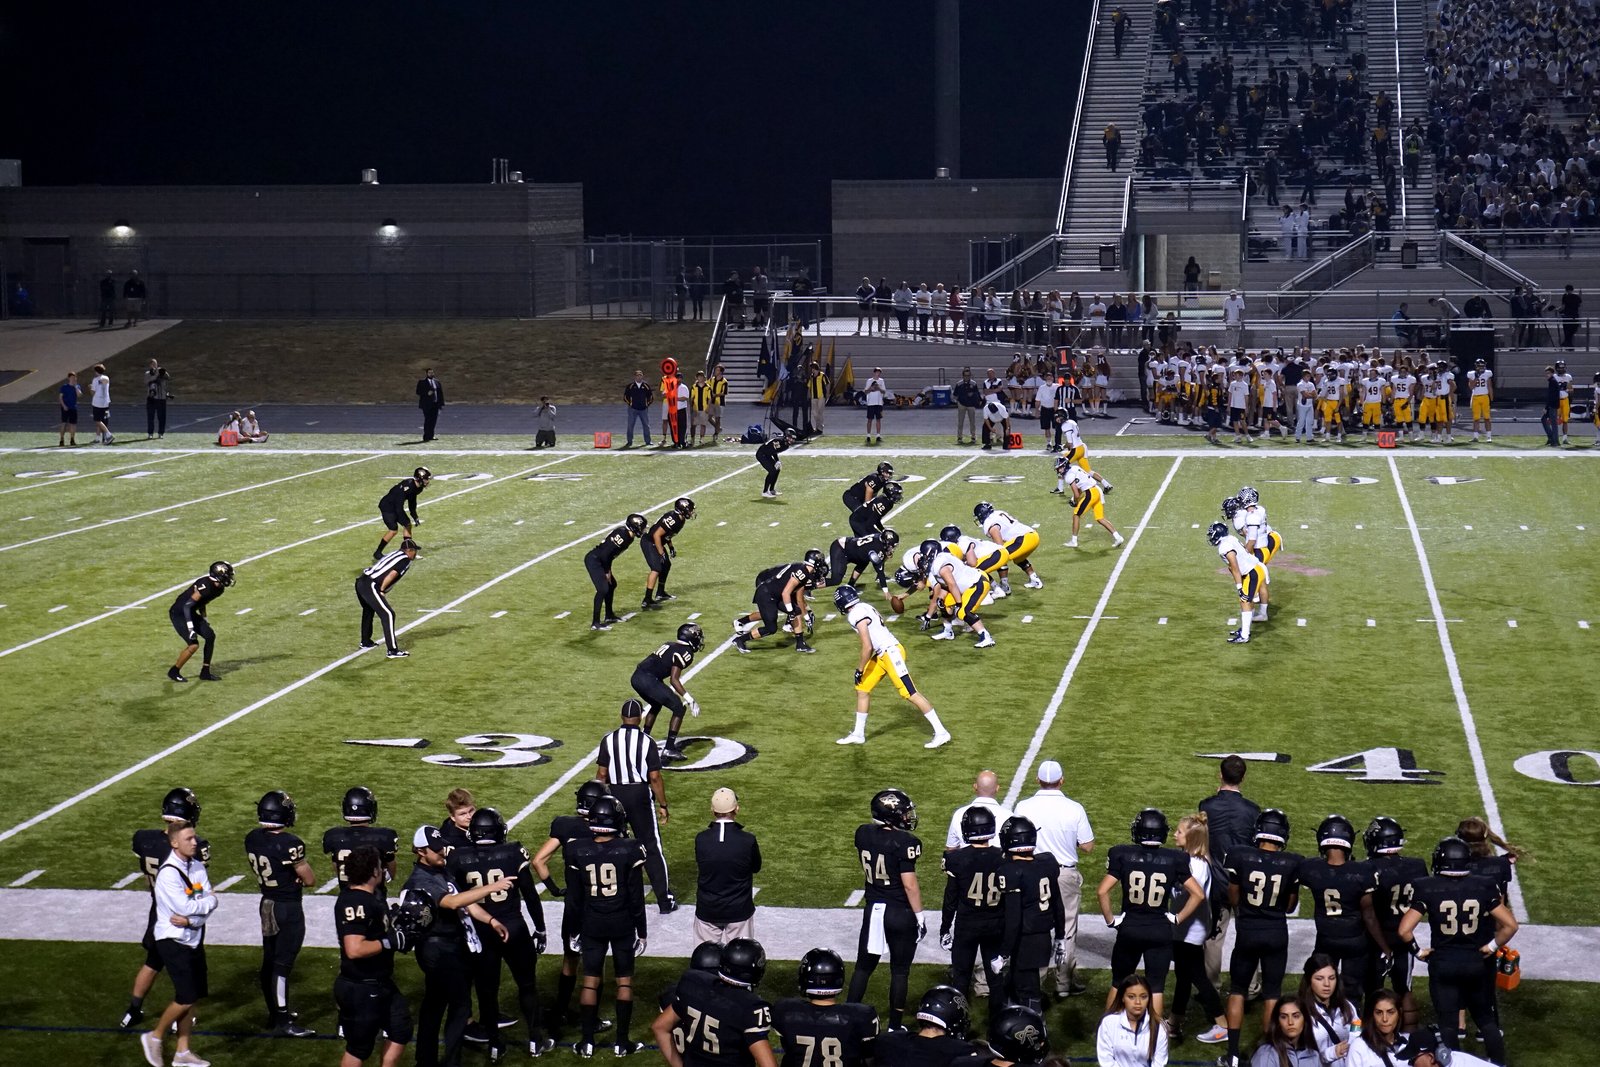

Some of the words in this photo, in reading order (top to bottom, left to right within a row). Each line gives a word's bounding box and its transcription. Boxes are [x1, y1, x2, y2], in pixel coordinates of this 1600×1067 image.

[1368, 386, 1378, 395] 49
[1009, 434, 1021, 446] 30
[1380, 433, 1394, 445] 40
[868, 480, 877, 489] 21
[876, 502, 886, 512] 42
[682, 650, 692, 662] 10
[288, 845, 304, 860] 32
[907, 844, 921, 859] 64
[861, 849, 891, 886] 64
[585, 862, 618, 897] 19
[1128, 870, 1167, 907] 86
[1247, 870, 1283, 907] 31
[1038, 876, 1052, 912] 9
[1324, 888, 1343, 916] 6
[344, 905, 366, 921] 94
[1439, 899, 1480, 936] 33
[753, 1006, 772, 1026] 75
[685, 1005, 721, 1055] 75
[795, 1034, 844, 1067] 78
